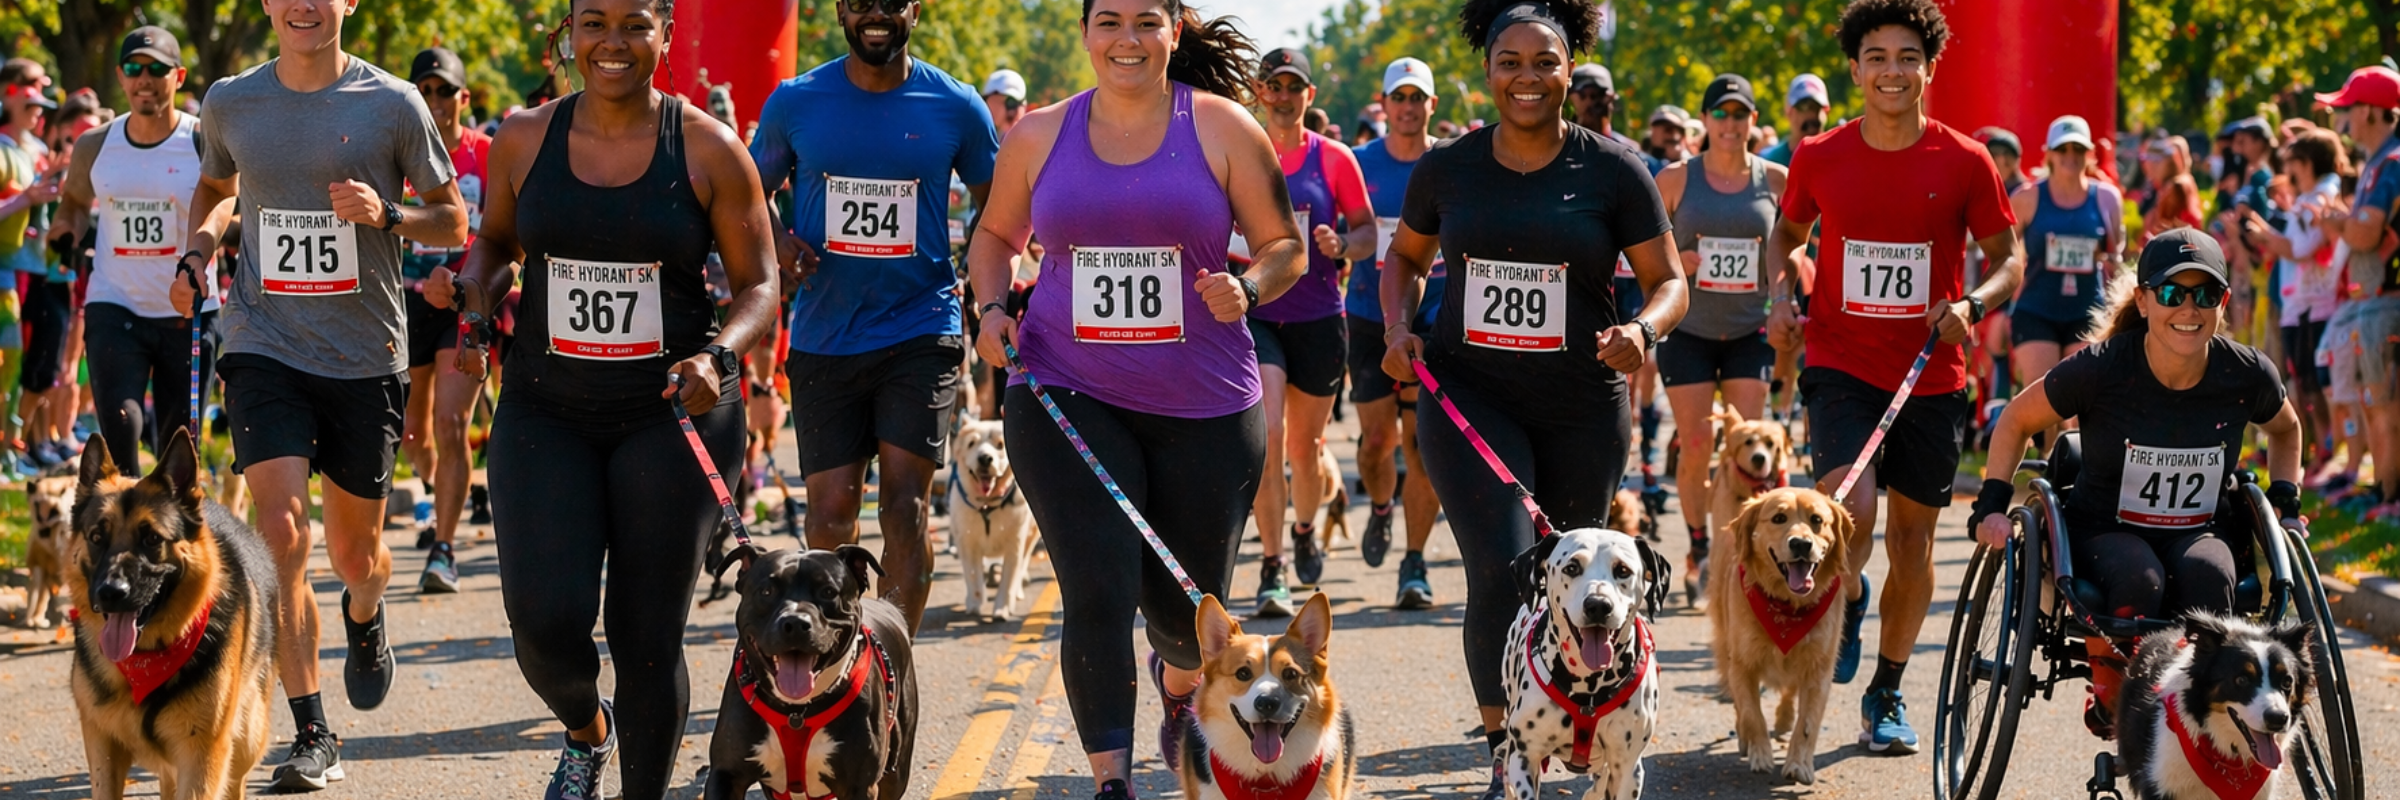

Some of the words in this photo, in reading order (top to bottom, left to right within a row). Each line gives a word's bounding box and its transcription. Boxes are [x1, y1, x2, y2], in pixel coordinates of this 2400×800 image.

[830, 180, 850, 195] FIRE
[852, 182, 897, 197] HYDRANT
[122, 216, 163, 244] 193
[263, 212, 283, 228] FIRE
[285, 214, 334, 229] HYDRANT
[842, 200, 899, 238] 254
[277, 234, 339, 273] 215
[1077, 251, 1100, 268] FIRE
[1103, 252, 1157, 268] HYDRANT
[1847, 243, 1865, 258] FIRE
[1869, 246, 1912, 260] HYDRANT
[552, 263, 575, 280] FIRE
[579, 265, 634, 283] HYDRANT
[1470, 262, 1491, 278] FIRE
[1495, 265, 1544, 283] HYDRANT
[1709, 253, 1748, 279] 332
[1860, 264, 1913, 299] 178
[1093, 275, 1162, 318] 318
[1483, 285, 1546, 328] 289
[568, 288, 638, 334] 367
[2130, 449, 2154, 466] FIRE
[2157, 452, 2205, 467] HYDRANT
[2139, 472, 2205, 509] 412
